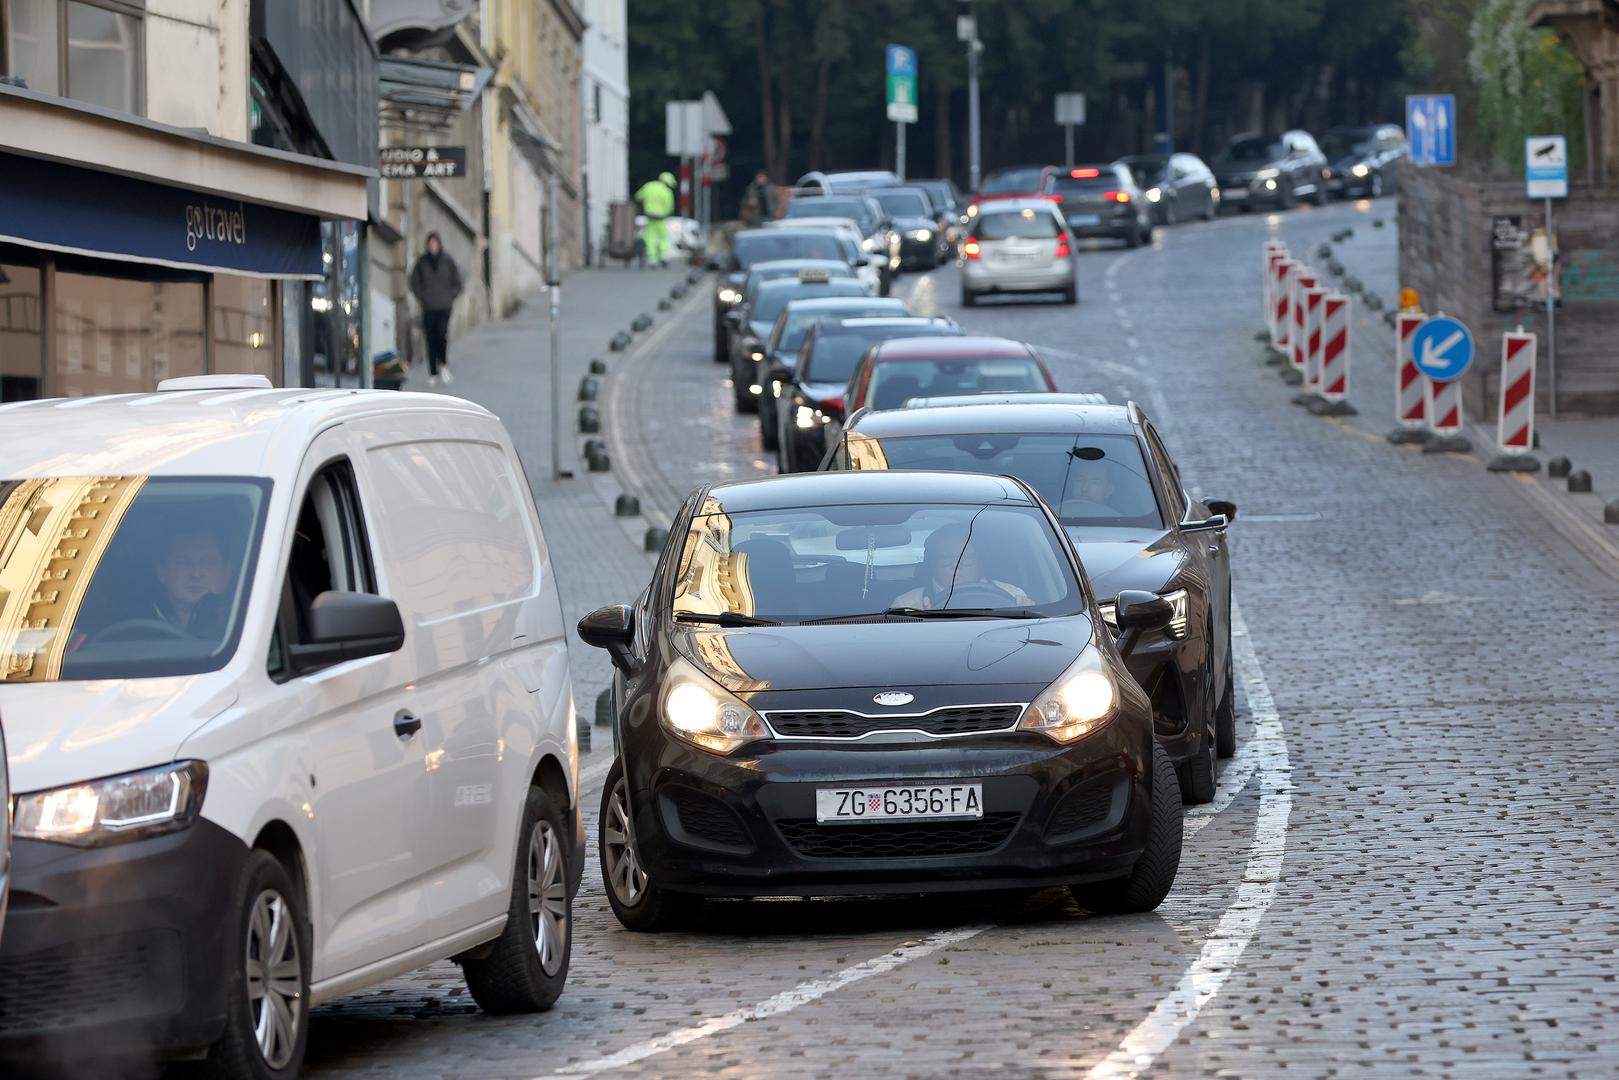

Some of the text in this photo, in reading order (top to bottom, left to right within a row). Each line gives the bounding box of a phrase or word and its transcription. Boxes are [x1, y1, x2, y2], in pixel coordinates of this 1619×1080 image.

[381, 149, 424, 162] UDIO
[382, 162, 457, 176] EMA ART
[835, 790, 866, 816] ZG
